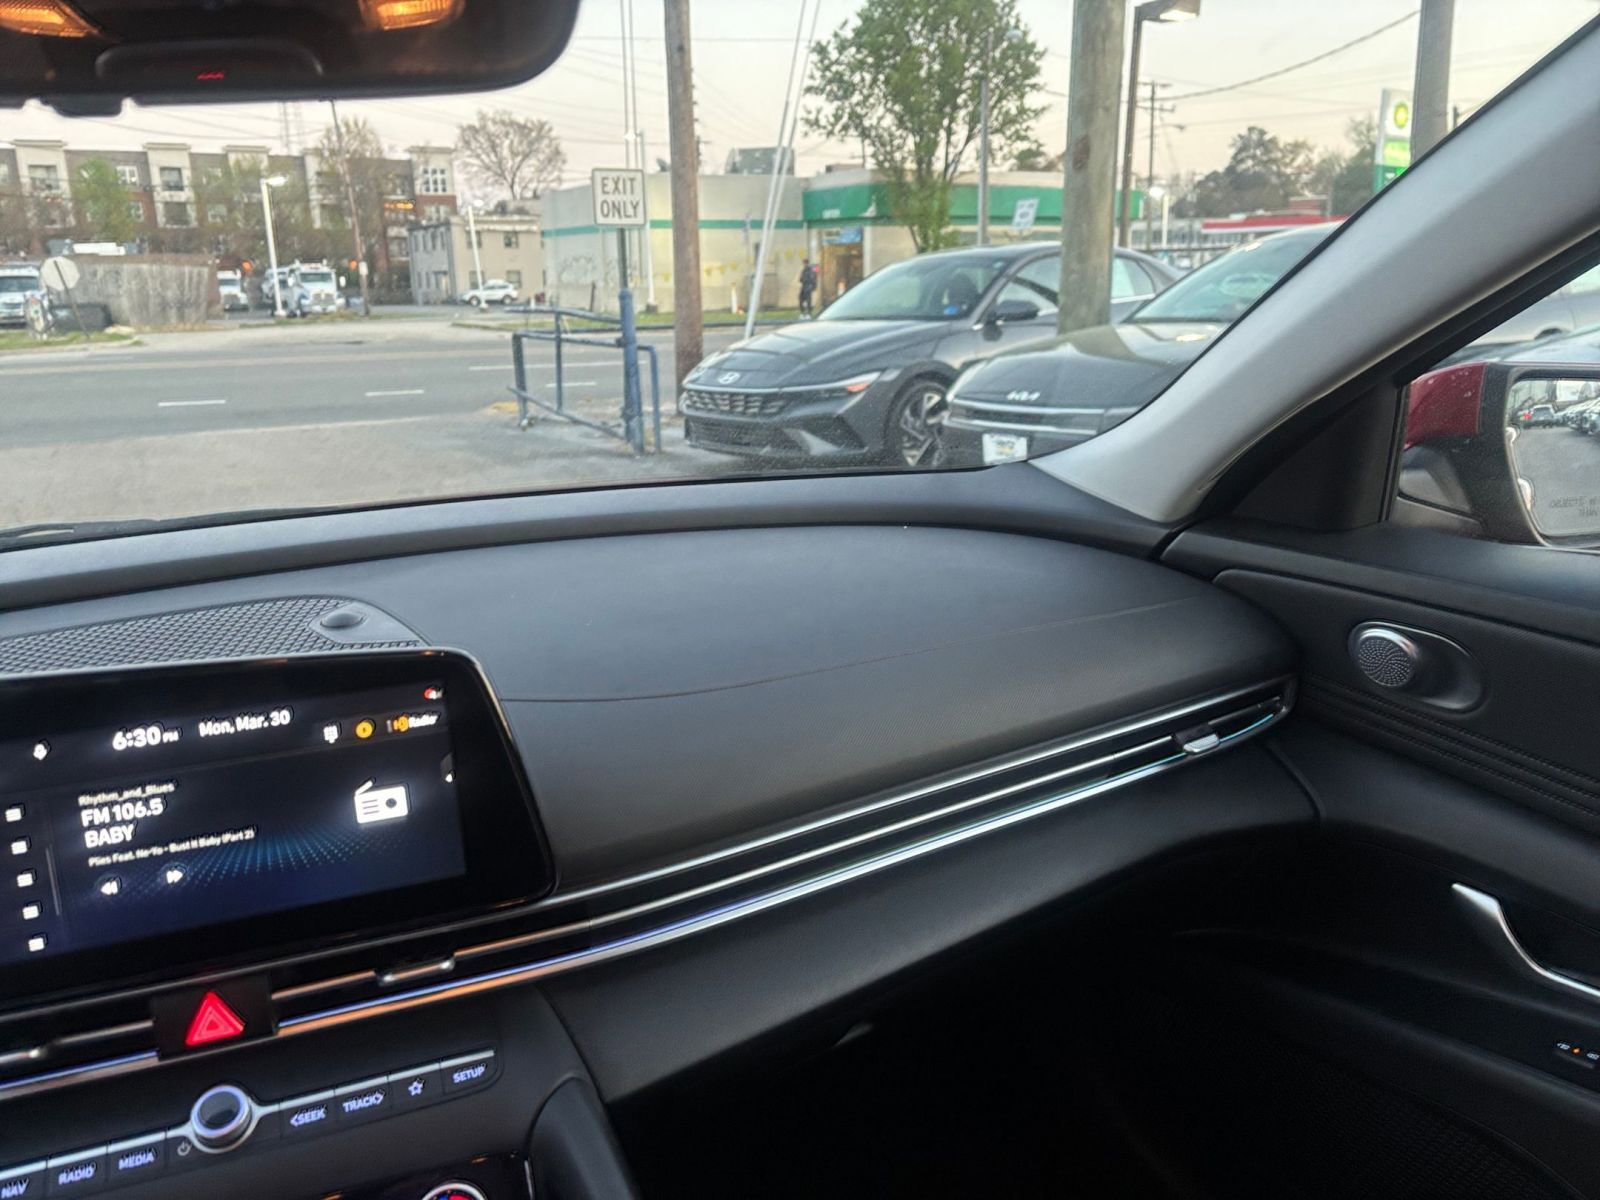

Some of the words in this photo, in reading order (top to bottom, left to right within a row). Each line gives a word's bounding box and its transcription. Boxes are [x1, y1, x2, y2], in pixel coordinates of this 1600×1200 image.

[601, 176, 636, 195] EXIT
[600, 199, 640, 220] ONLY
[199, 720, 235, 737] Mon,
[235, 714, 269, 731] Mar.
[270, 709, 292, 726] 30
[112, 725, 162, 751] 6:30
[81, 807, 110, 827] FM
[112, 797, 164, 821] 106.5
[84, 823, 135, 848] BABY
[453, 1066, 485, 1083] SETUP
[343, 1094, 377, 1112] TRACK
[118, 1152, 155, 1170] MEDIA
[58, 1164, 95, 1185] RADIO
[1, 1181, 28, 1199] NAV
